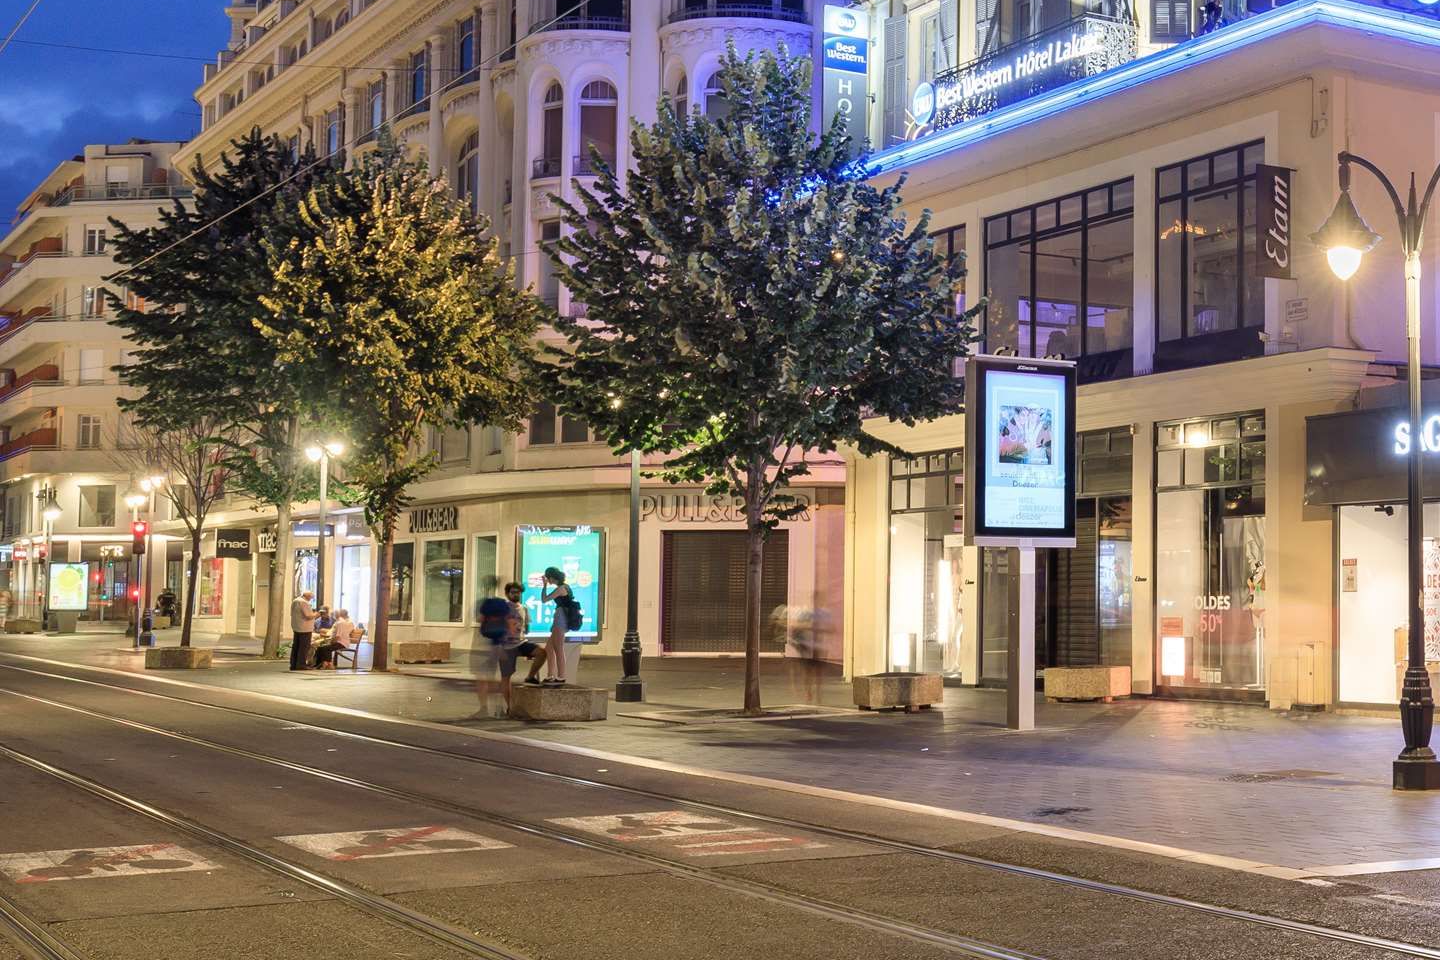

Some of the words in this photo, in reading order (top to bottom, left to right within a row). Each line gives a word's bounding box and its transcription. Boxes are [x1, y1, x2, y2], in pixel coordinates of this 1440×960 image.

[835, 41, 857, 54] Best
[936, 82, 962, 109] Best
[961, 64, 1013, 97] Western
[1014, 42, 1052, 80] Hôtel
[1265, 175, 1289, 268] Etam
[408, 506, 458, 533] PULL&BEAR
[638, 494, 811, 523] PULL&BR
[217, 538, 249, 550] fnac
[1192, 595, 1231, 610] OLDES
